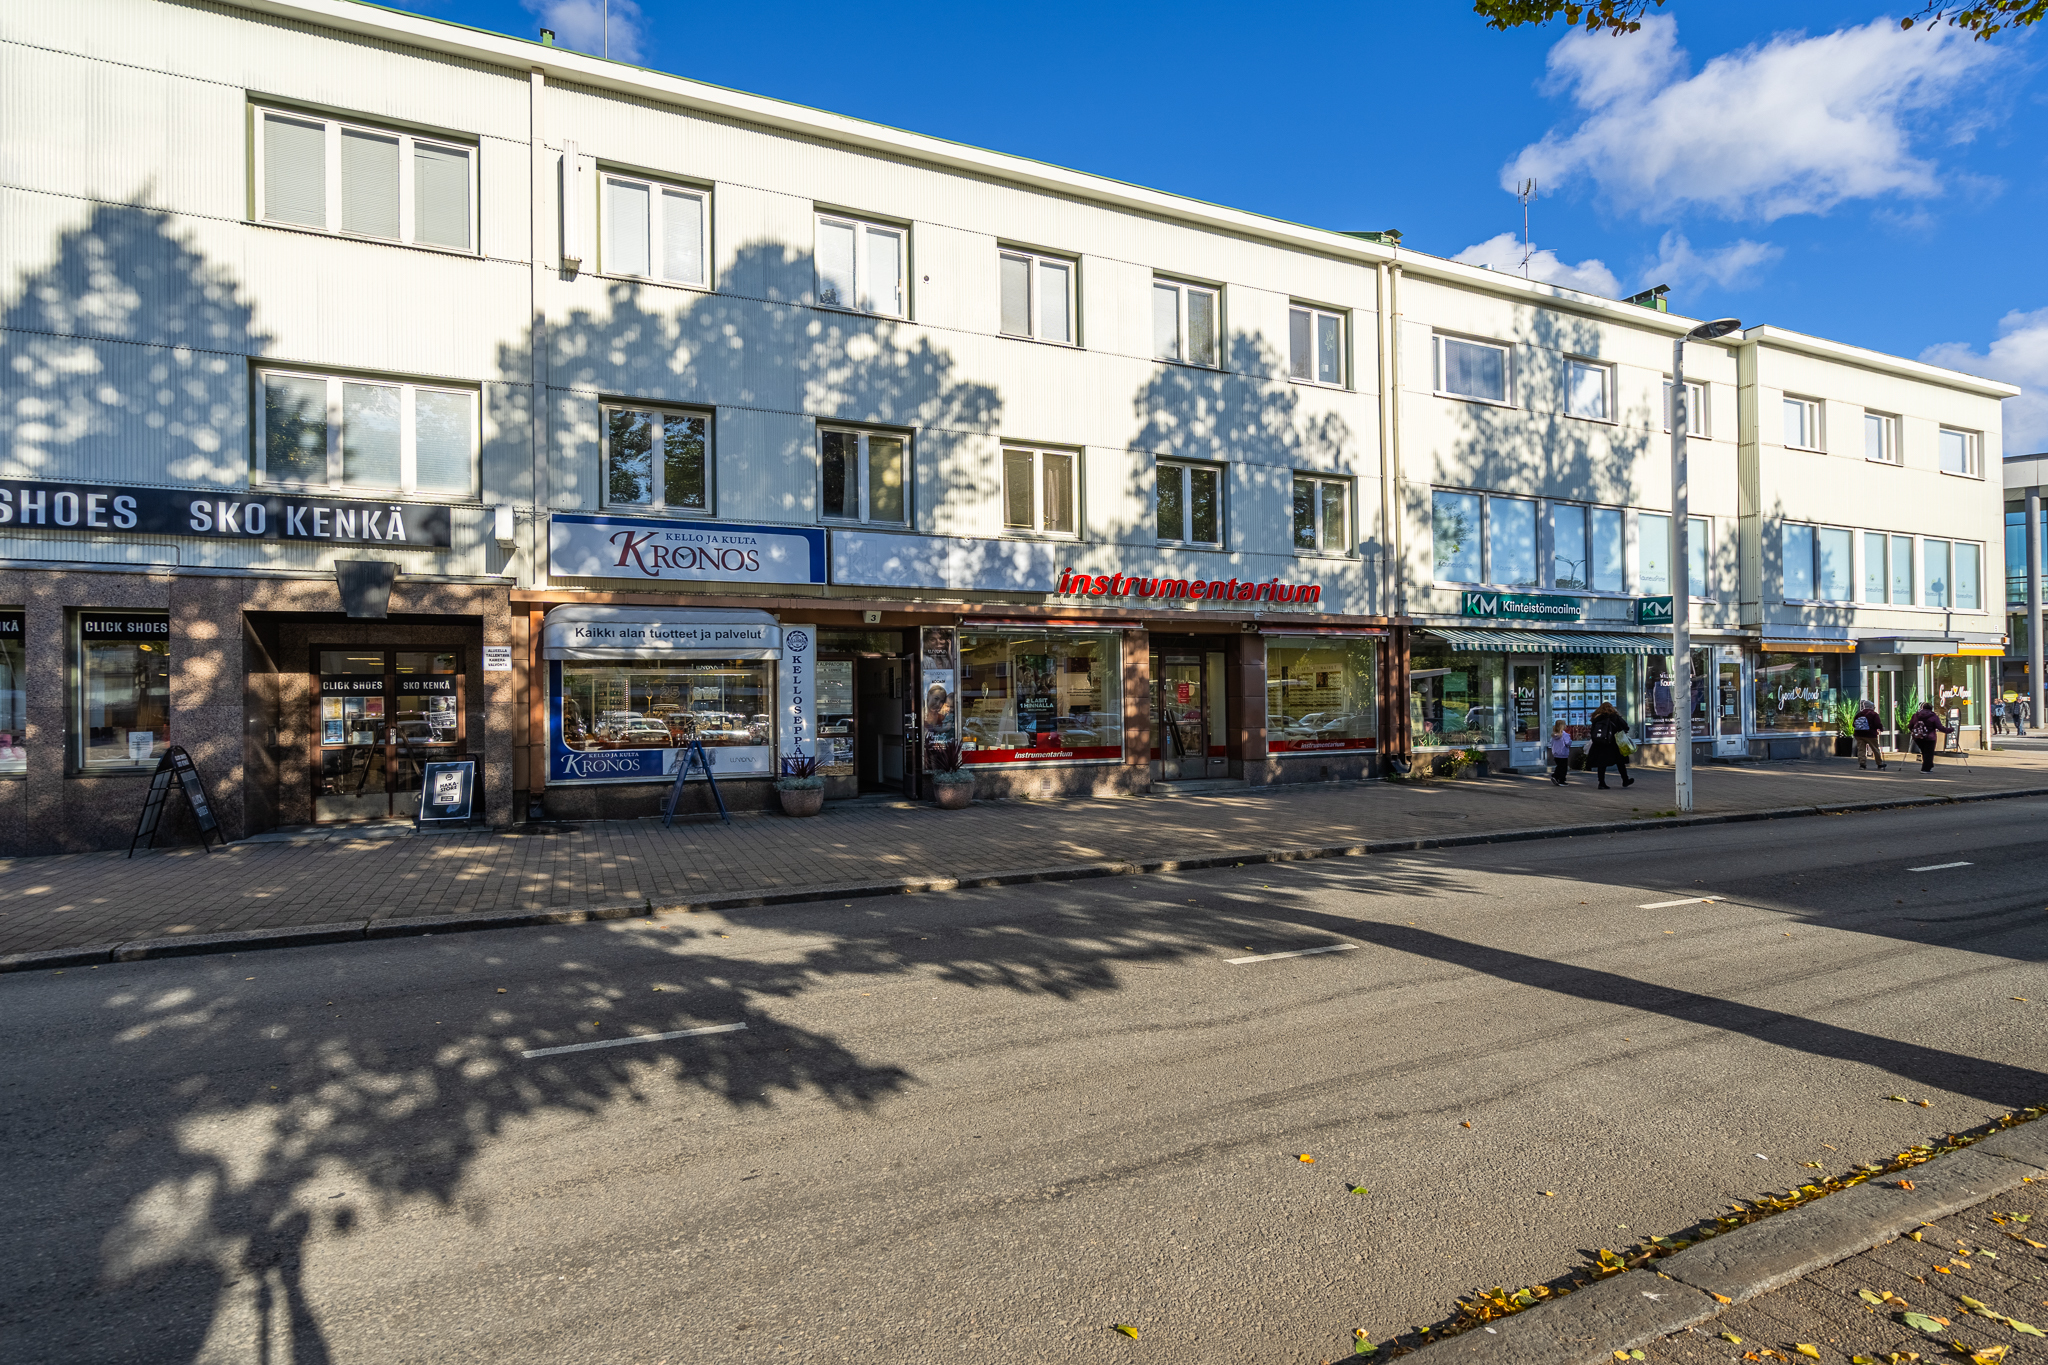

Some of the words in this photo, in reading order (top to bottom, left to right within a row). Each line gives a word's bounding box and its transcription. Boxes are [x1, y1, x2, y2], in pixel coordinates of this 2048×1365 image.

[0, 488, 138, 529] SHOES
[189, 500, 266, 534] SKO
[286, 505, 407, 541] KENKÄ
[665, 532, 704, 543] KELLO
[706, 535, 719, 544] JA
[722, 536, 757, 545] KULTA
[609, 531, 760, 577] KRONOS
[1059, 567, 1321, 603] instrumentarium
[1467, 593, 1498, 615] KM
[1502, 600, 1581, 615] Kiinteistömaailma
[1642, 601, 1672, 616] KM
[85, 621, 122, 633] CLICK
[127, 622, 168, 633] SHOES
[575, 628, 615, 638] Kaikki
[619, 628, 646, 638] alan
[650, 629, 698, 639] tuotteet
[700, 629, 711, 641] ja
[715, 629, 762, 641] palvelut
[322, 681, 350, 690] CLICK
[352, 681, 383, 690] SHOES
[403, 681, 420, 690] SKO
[423, 680, 451, 690] KENKÄ
[1518, 686, 1535, 699] KM
[792, 655, 804, 755] KELLOSEPPÄ
[1777, 684, 1796, 711] Good
[1800, 687, 1819, 701] Mood
[1300, 740, 1346, 749] instrumentarium
[1014, 750, 1073, 759] instrumentarium
[561, 753, 641, 777] KRONOS
